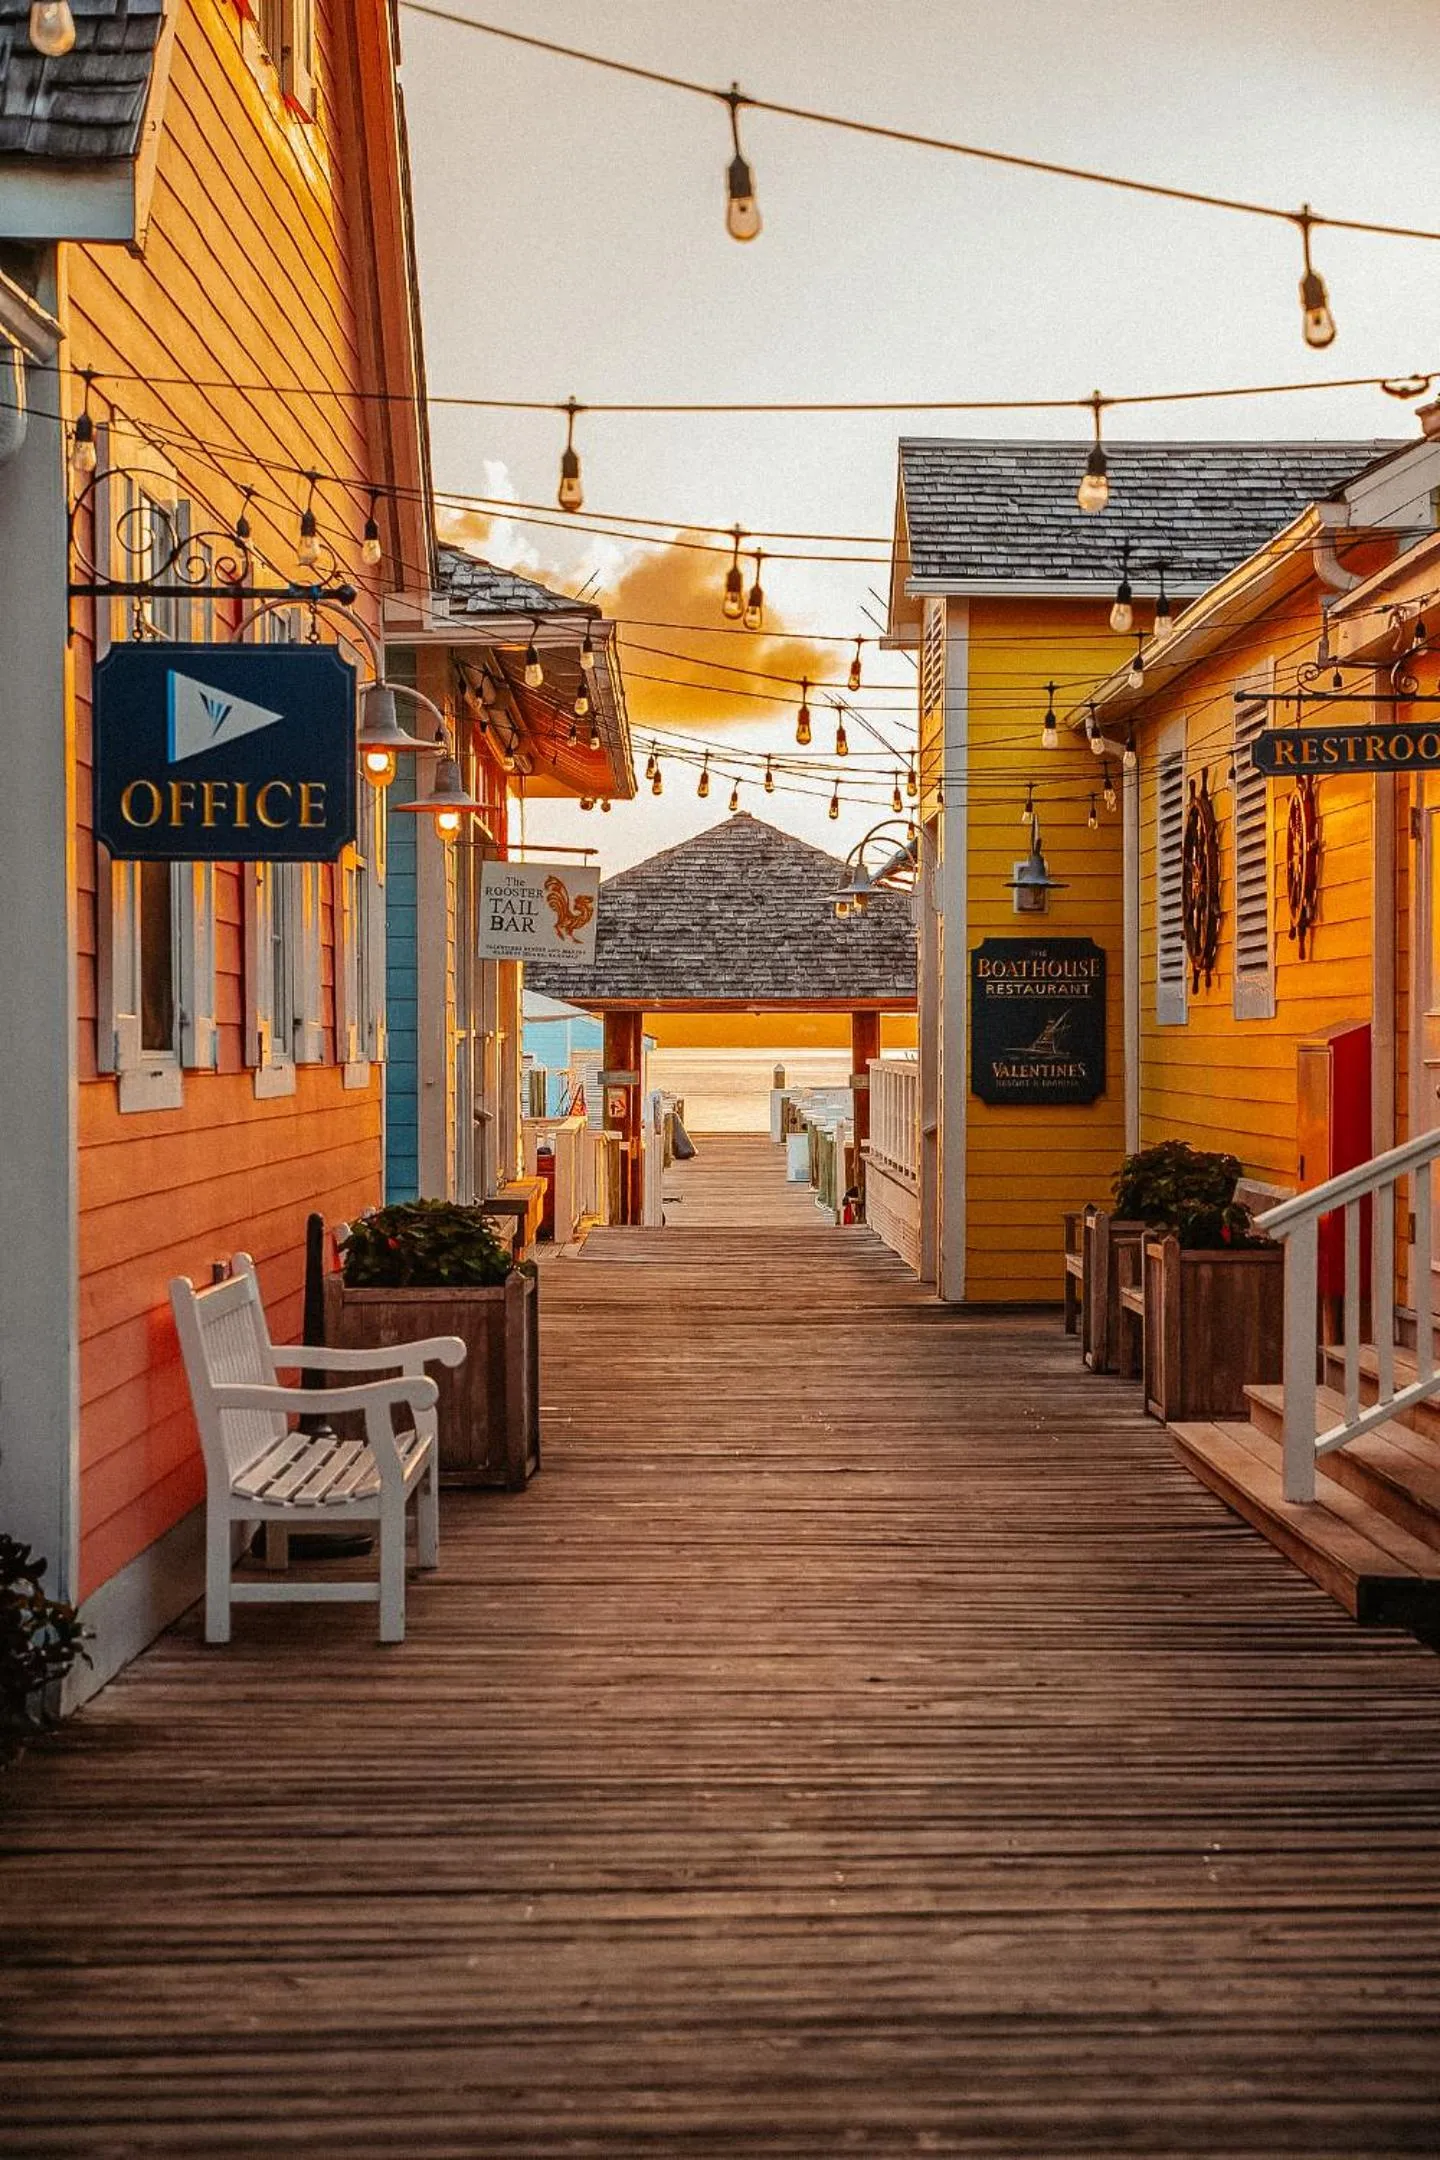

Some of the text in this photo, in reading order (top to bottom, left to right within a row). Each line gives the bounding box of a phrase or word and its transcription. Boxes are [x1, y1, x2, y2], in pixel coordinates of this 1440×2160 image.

[1275, 734, 1440, 765] RESTROO
[120, 780, 327, 828] OFFICE
[506, 876, 526, 887] The
[485, 887, 544, 898] ROOSTER
[490, 898, 539, 916] TAIL
[490, 915, 536, 933] BAR
[977, 958, 1100, 978] BOATHOUSE
[985, 984, 1091, 995] RESTAURANT
[992, 1062, 1086, 1078] VALENTINES
